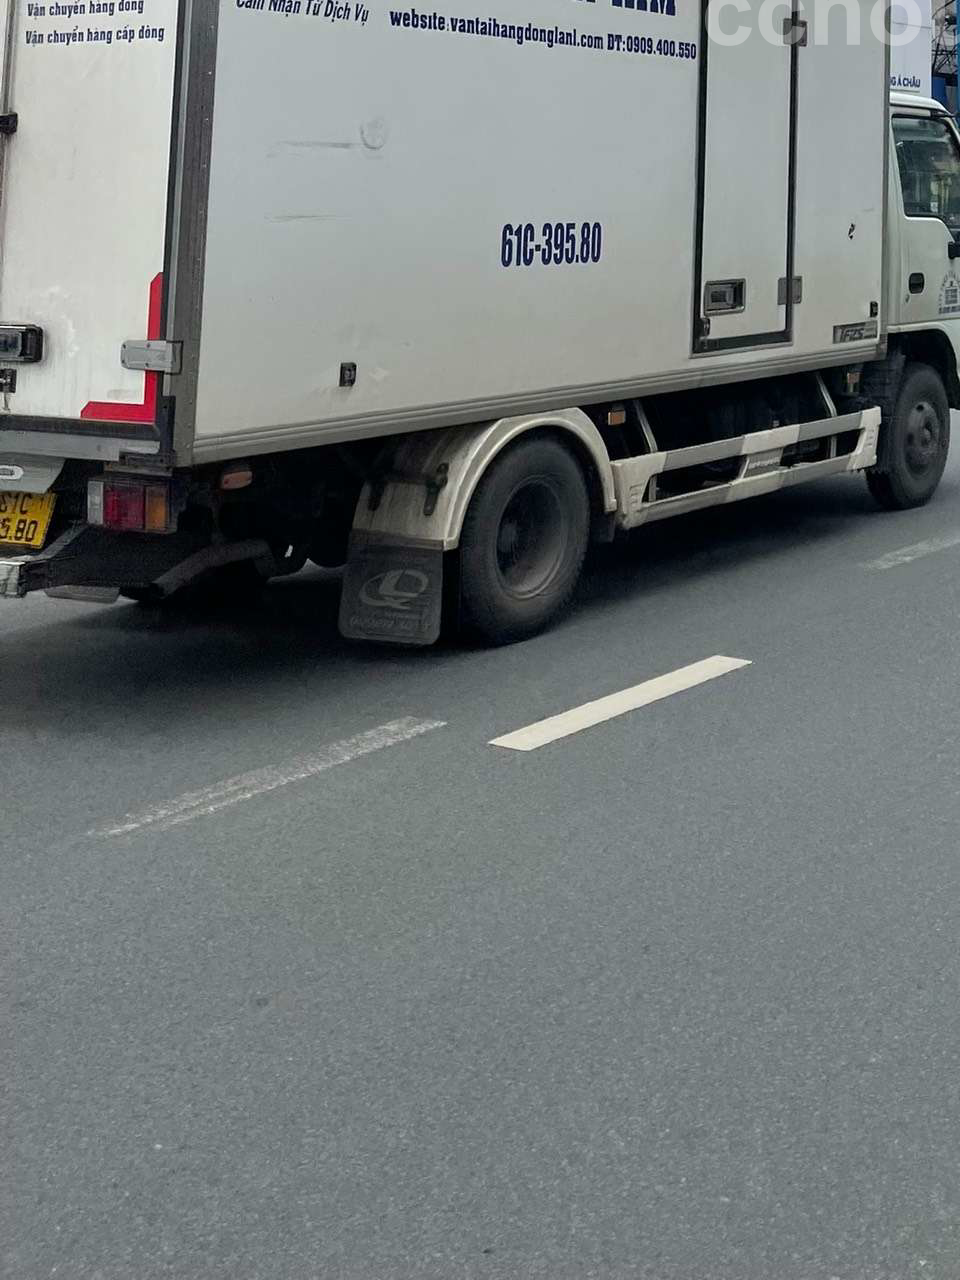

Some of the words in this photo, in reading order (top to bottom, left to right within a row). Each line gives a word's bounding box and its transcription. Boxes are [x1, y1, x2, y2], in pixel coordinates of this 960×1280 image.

[324, 0, 351, 22] Dịch
[354, 3, 369, 26] Vụ
[501, 222, 602, 267] 61C-395.80
